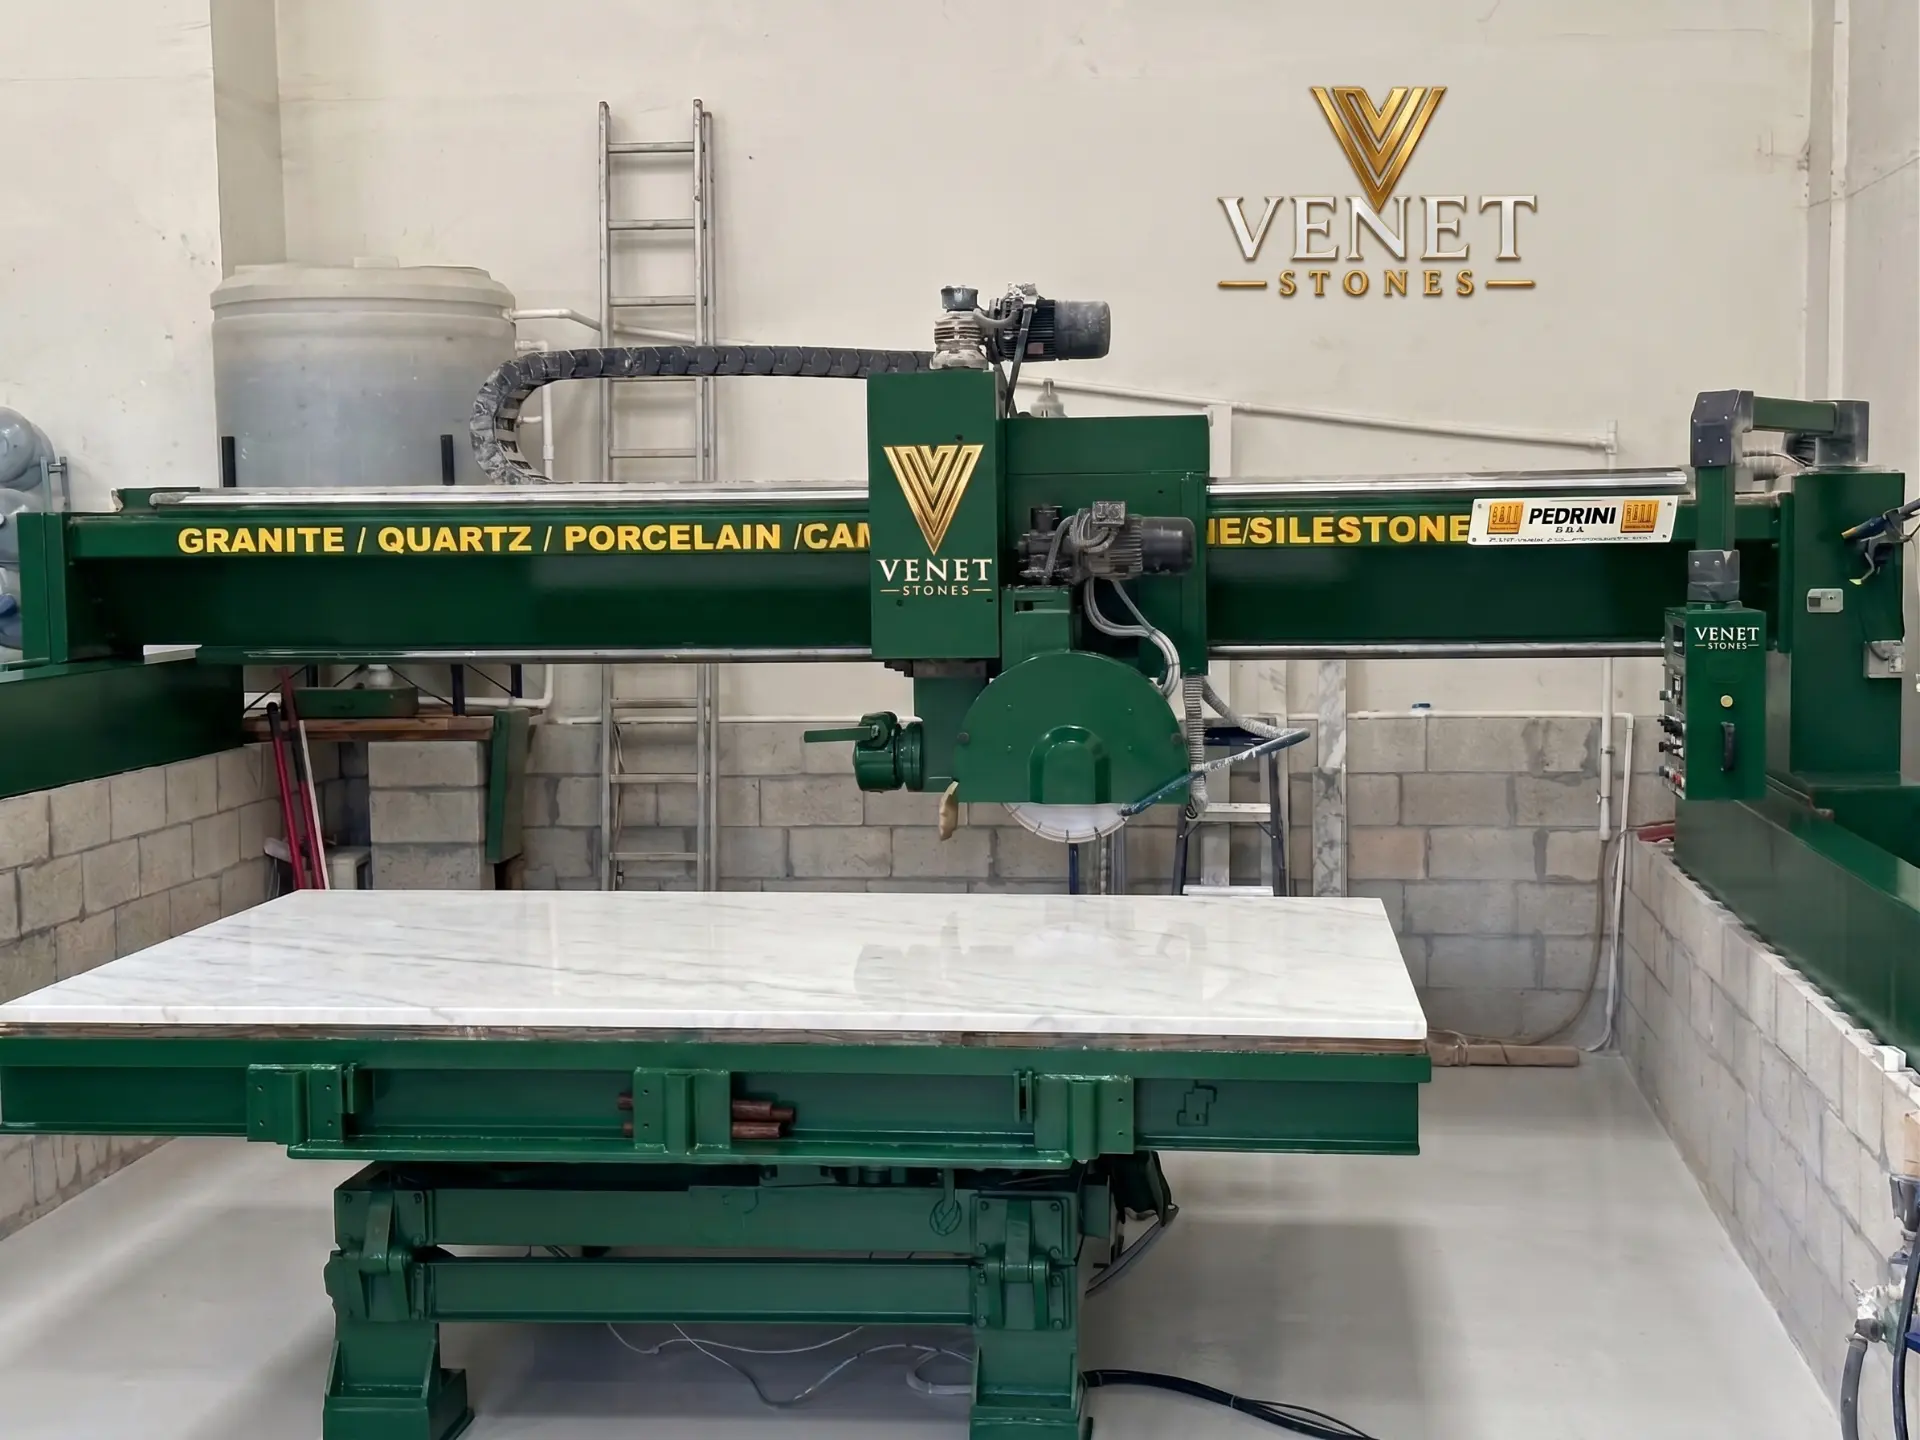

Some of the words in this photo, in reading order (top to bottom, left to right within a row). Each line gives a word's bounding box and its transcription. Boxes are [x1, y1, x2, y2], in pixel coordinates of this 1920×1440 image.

[1217, 194, 1538, 261] VENET
[1279, 269, 1475, 297] STONES
[1528, 506, 1617, 525] PEDRINI
[178, 527, 345, 553] GRANITE
[377, 526, 532, 554] QUARTZ
[565, 524, 781, 551] PORCELAIN
[876, 558, 993, 582] VENET
[902, 585, 969, 596] STONES
[1694, 626, 1760, 641] VENET
[1707, 642, 1748, 650] STONES
